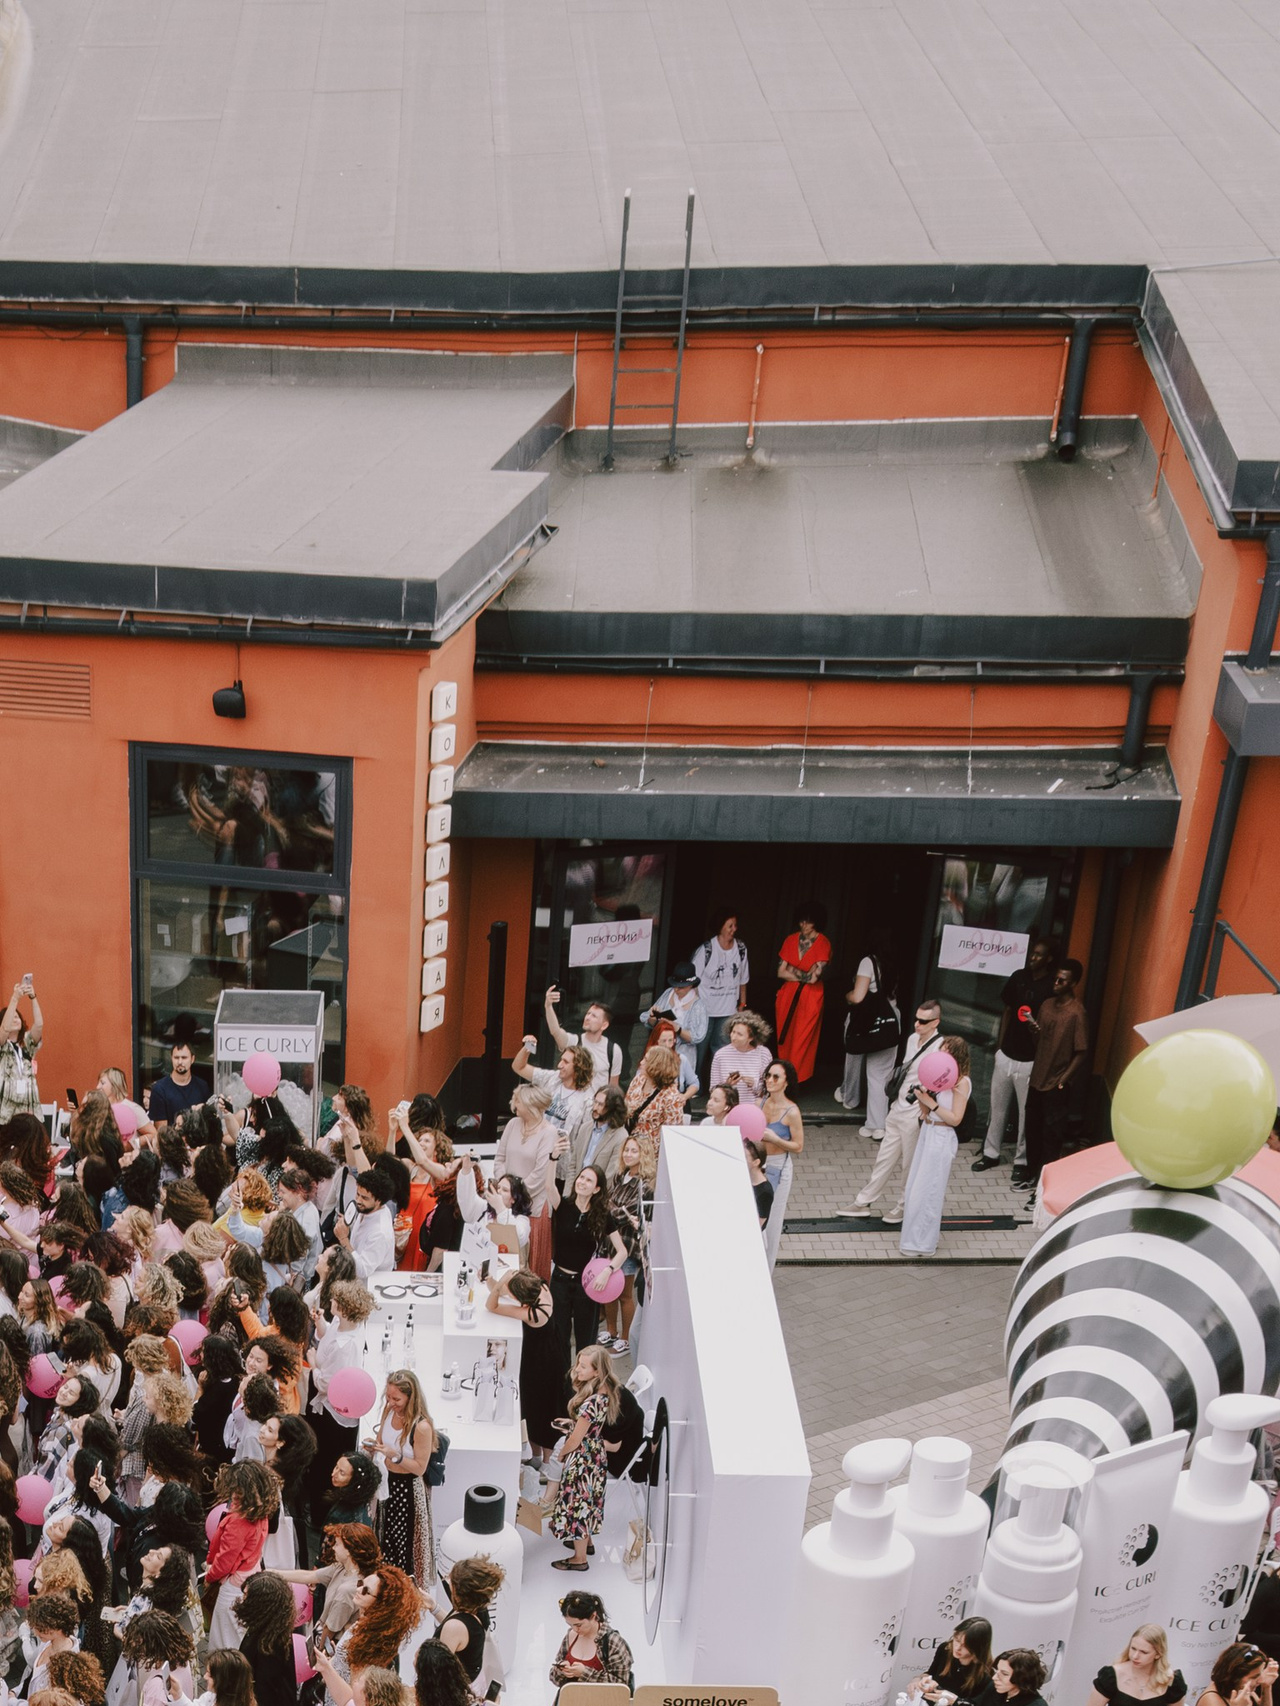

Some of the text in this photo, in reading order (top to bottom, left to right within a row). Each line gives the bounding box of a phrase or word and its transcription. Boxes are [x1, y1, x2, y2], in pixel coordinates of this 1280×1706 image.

[433, 694, 453, 1022] КОТЕЛЬНАЯ
[586, 932, 638, 945] ЛЕКТОРИЙ
[958, 940, 1012, 954] ЛЕКТОРИЙ
[220, 1037, 313, 1053] ICE CURLY
[1170, 1617, 1201, 1633] ICE
[911, 1636, 943, 1650] ICE
